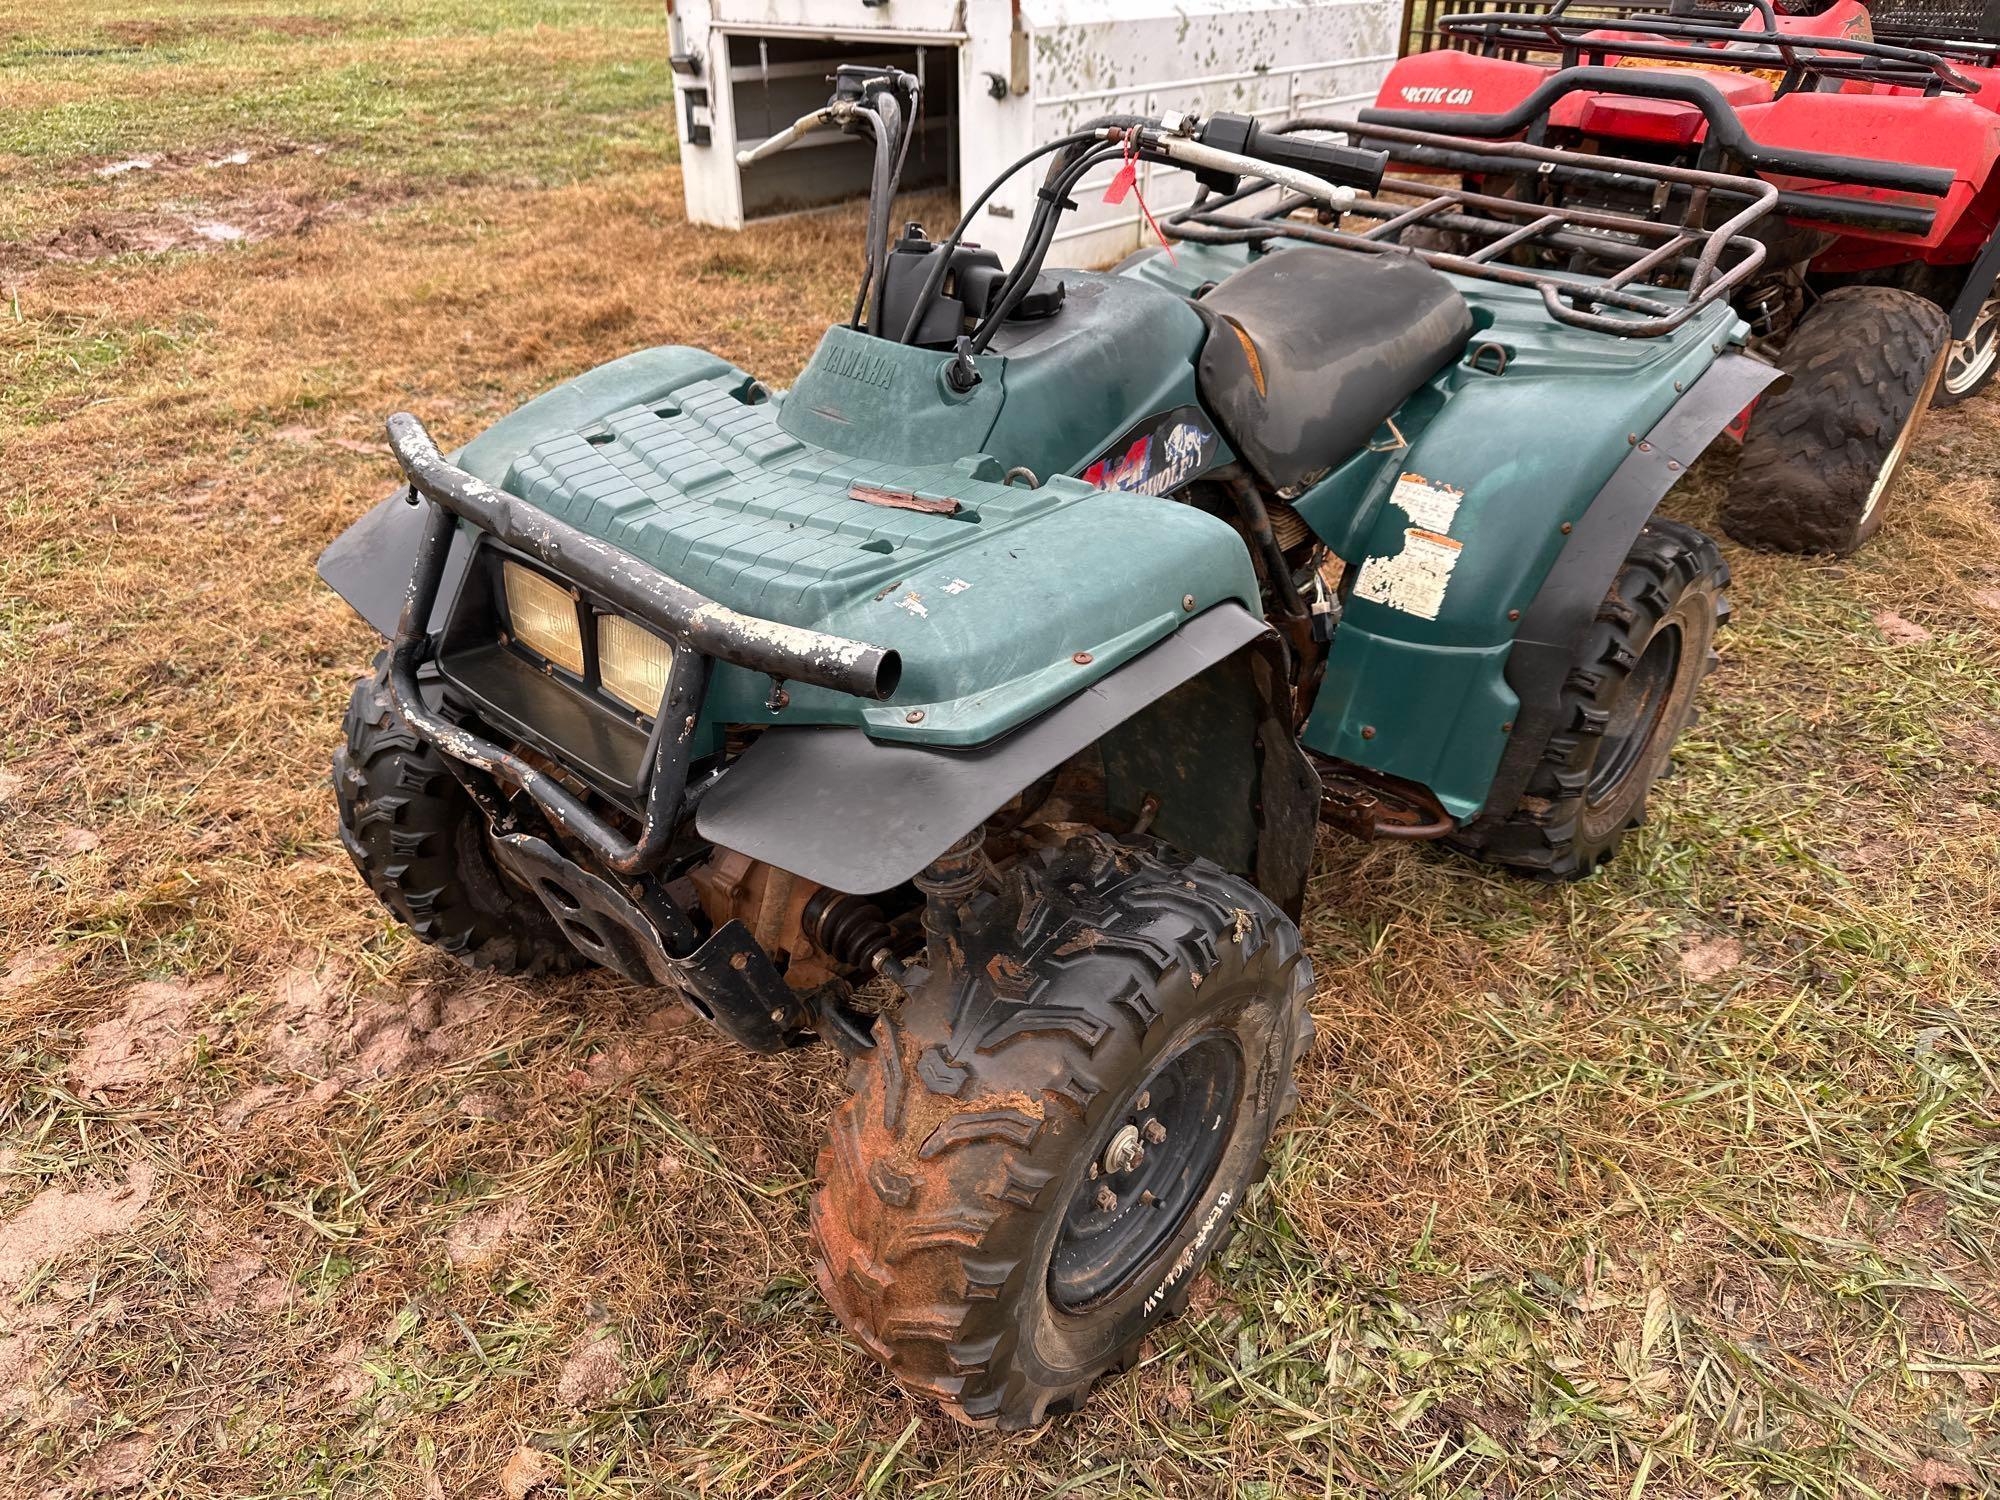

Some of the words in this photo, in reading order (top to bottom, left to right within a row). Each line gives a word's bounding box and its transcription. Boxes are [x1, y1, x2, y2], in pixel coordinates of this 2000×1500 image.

[1400, 86, 1448, 104] ARCTIC
[823, 345, 898, 390] YAMAHA
[1194, 1190, 1233, 1250] BEAR
[1143, 1264, 1183, 1318] CLAW
